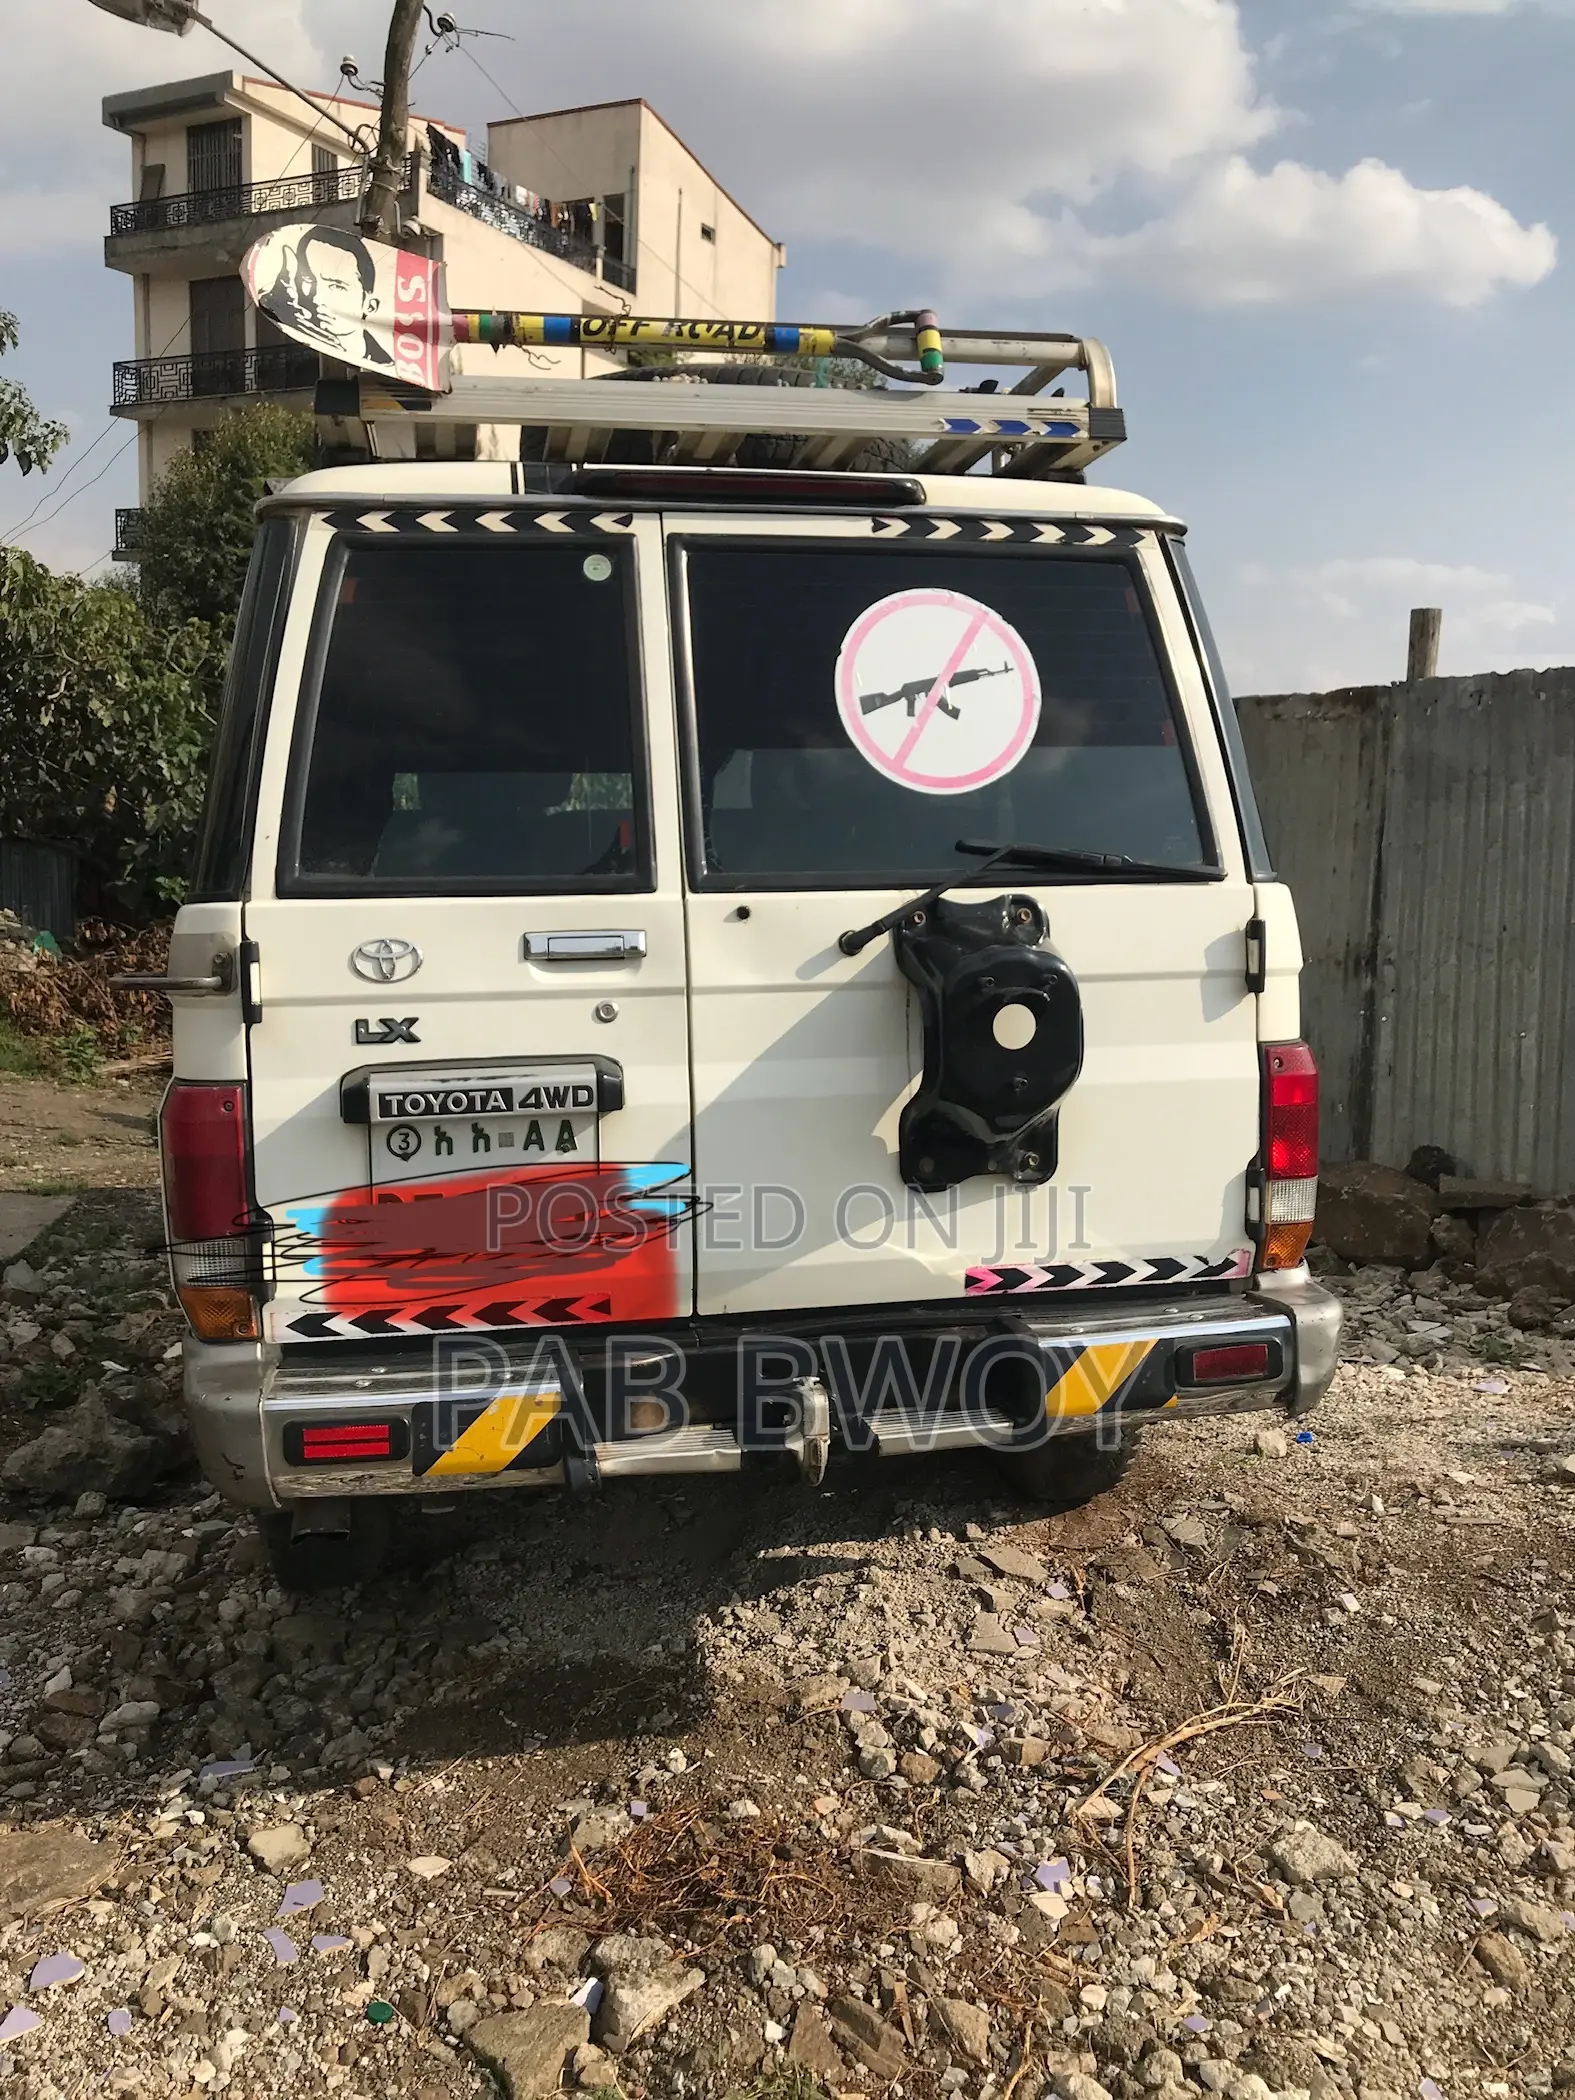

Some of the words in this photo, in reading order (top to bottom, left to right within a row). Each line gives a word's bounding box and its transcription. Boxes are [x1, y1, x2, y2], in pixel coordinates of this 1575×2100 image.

[394, 275, 428, 387] BOSS
[582, 317, 650, 337] OFF
[661, 319, 762, 341] ROAD
[355, 1017, 421, 1044] LX
[385, 1090, 507, 1116] TOYOTA
[518, 1085, 594, 1110] 4WD
[523, 1119, 578, 1152] AA
